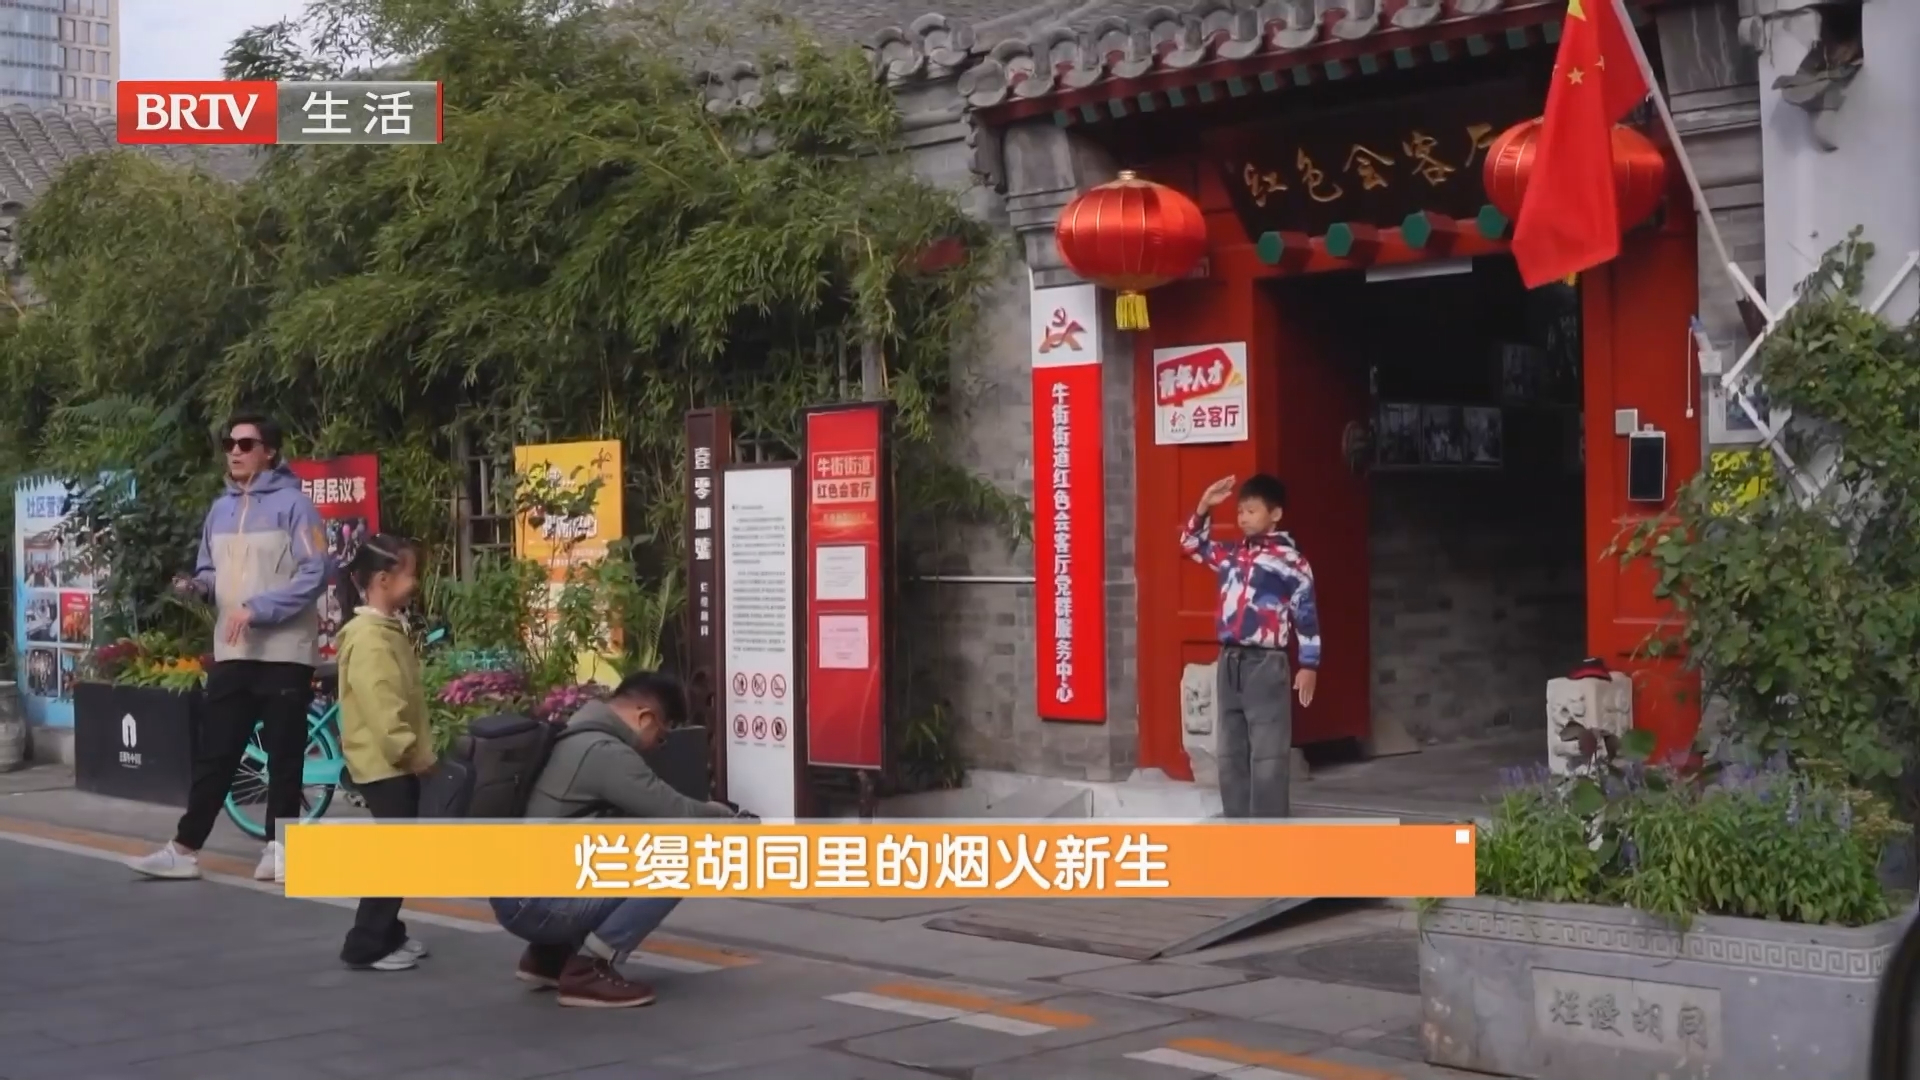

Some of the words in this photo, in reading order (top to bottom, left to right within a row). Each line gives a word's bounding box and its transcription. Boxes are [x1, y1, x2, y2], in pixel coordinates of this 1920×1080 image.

[1192, 405, 1240, 429] 会客厅
[817, 457, 872, 477] 牛街街道
[817, 481, 872, 499] 红色会客厅
